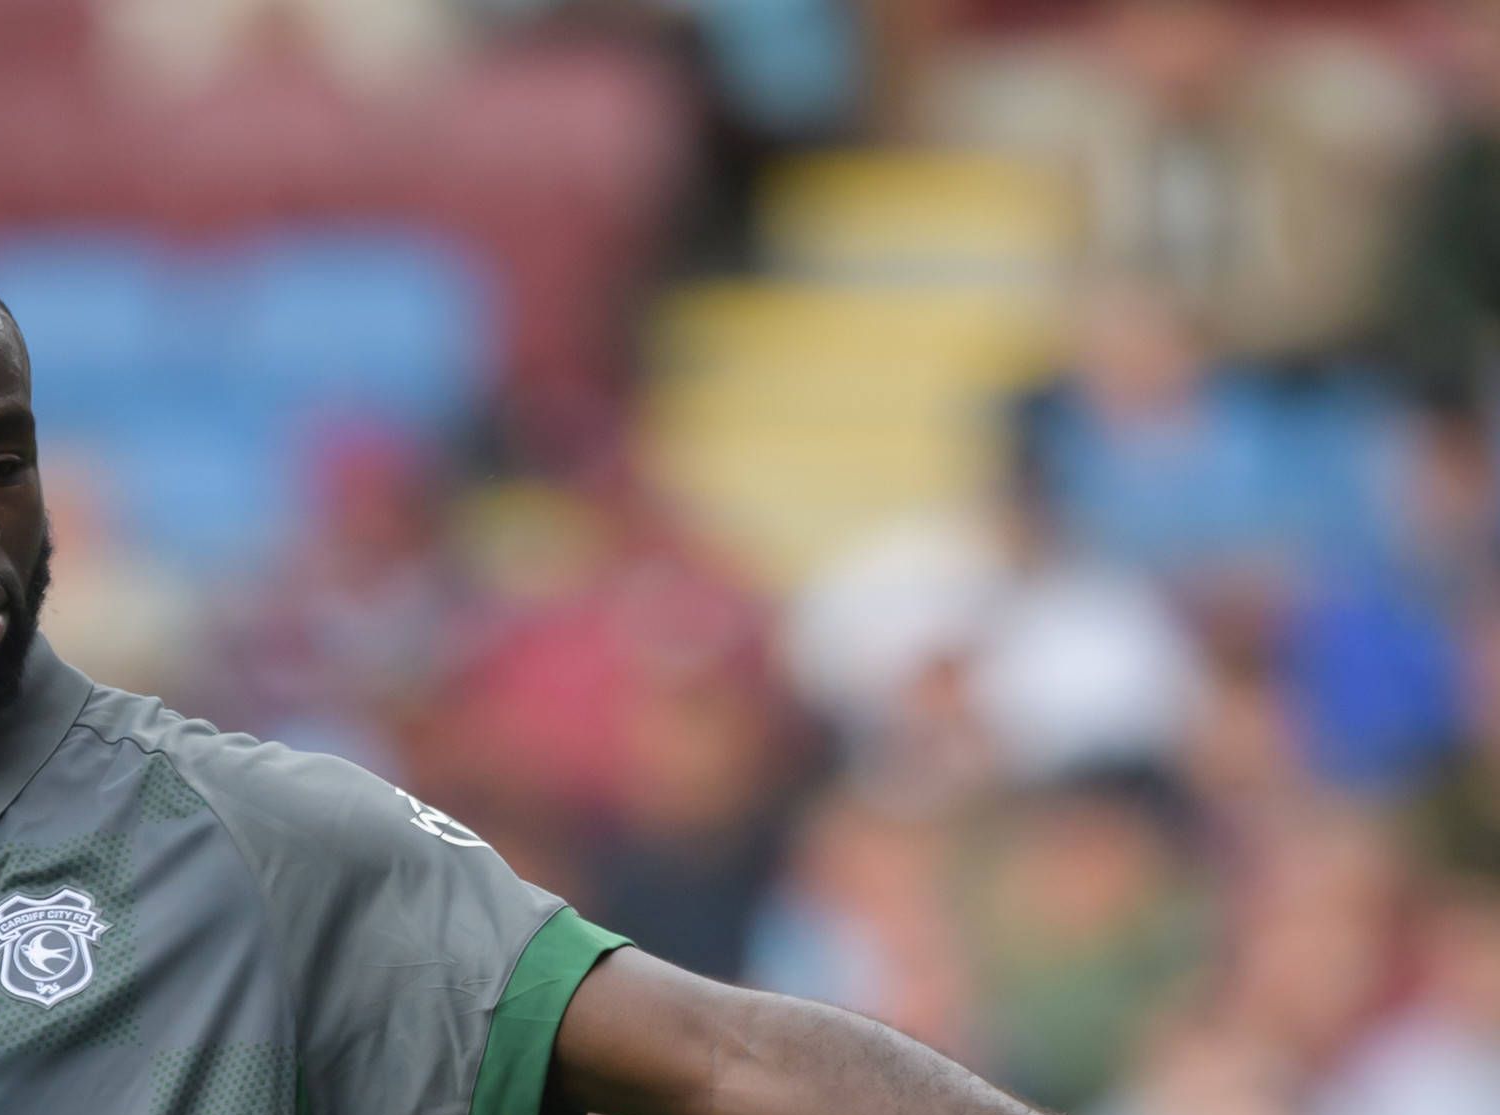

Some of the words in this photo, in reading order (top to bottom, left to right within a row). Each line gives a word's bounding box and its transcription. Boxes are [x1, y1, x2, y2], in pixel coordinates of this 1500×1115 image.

[0, 912, 45, 931] CARDIFF
[47, 910, 71, 920] CITY
[73, 913, 88, 924] FC
